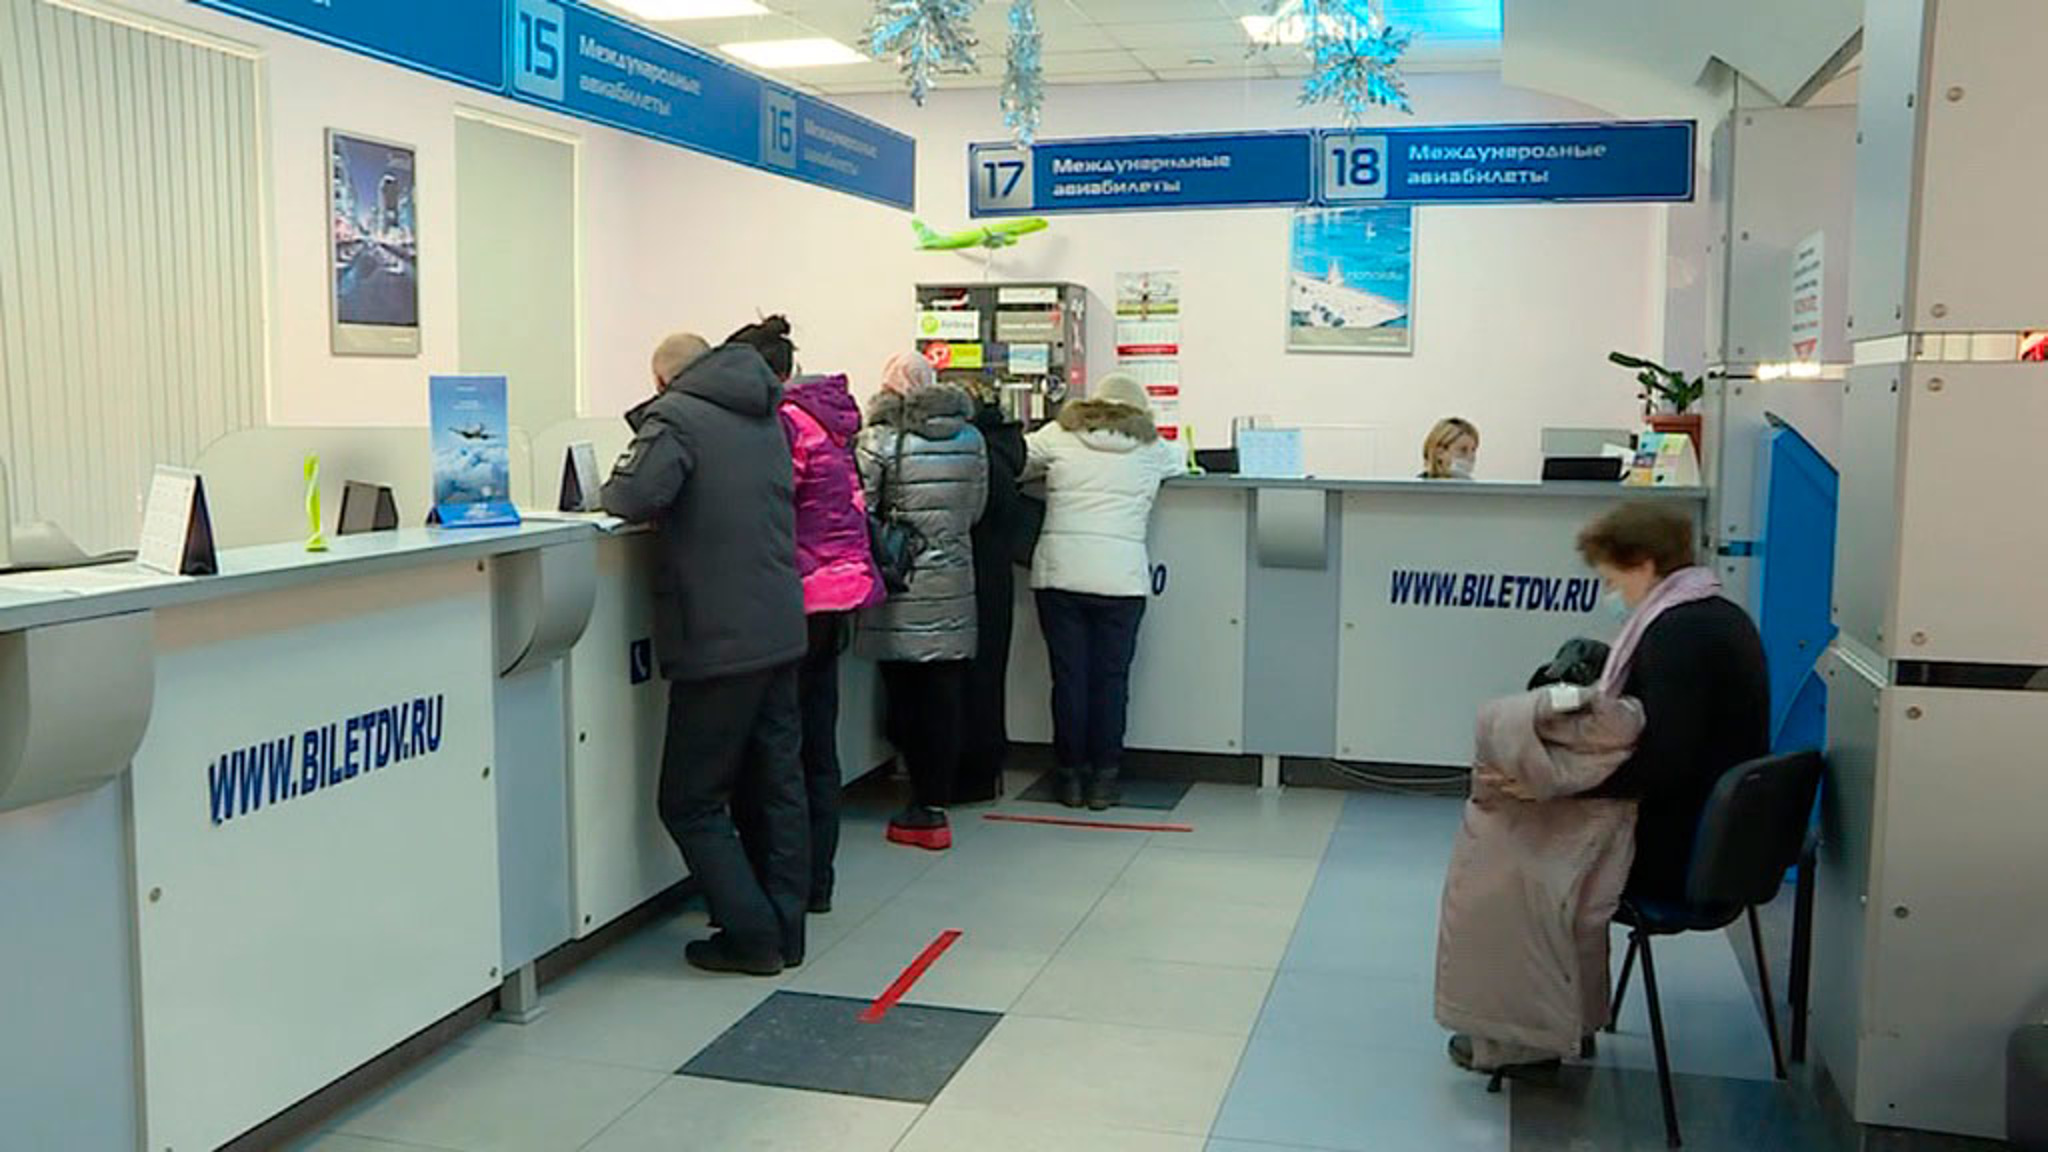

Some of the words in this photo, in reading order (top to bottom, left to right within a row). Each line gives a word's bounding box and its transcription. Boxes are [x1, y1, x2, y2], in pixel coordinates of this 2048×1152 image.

[519, 13, 559, 81] 15
[578, 34, 702, 97] Международные
[578, 73, 673, 117] авиабилеты
[769, 104, 793, 153] 16
[1052, 155, 1232, 176] Международные
[1331, 147, 1381, 187] 18
[1407, 140, 1608, 165] Международные
[982, 161, 1025, 199] 17
[1052, 178, 1182, 198] авиабилеты
[1406, 166, 1550, 187] авиабилеты
[1390, 569, 1599, 613] WWW.BILETDV.RU
[207, 694, 444, 827] WWW.BILETDV.RU
